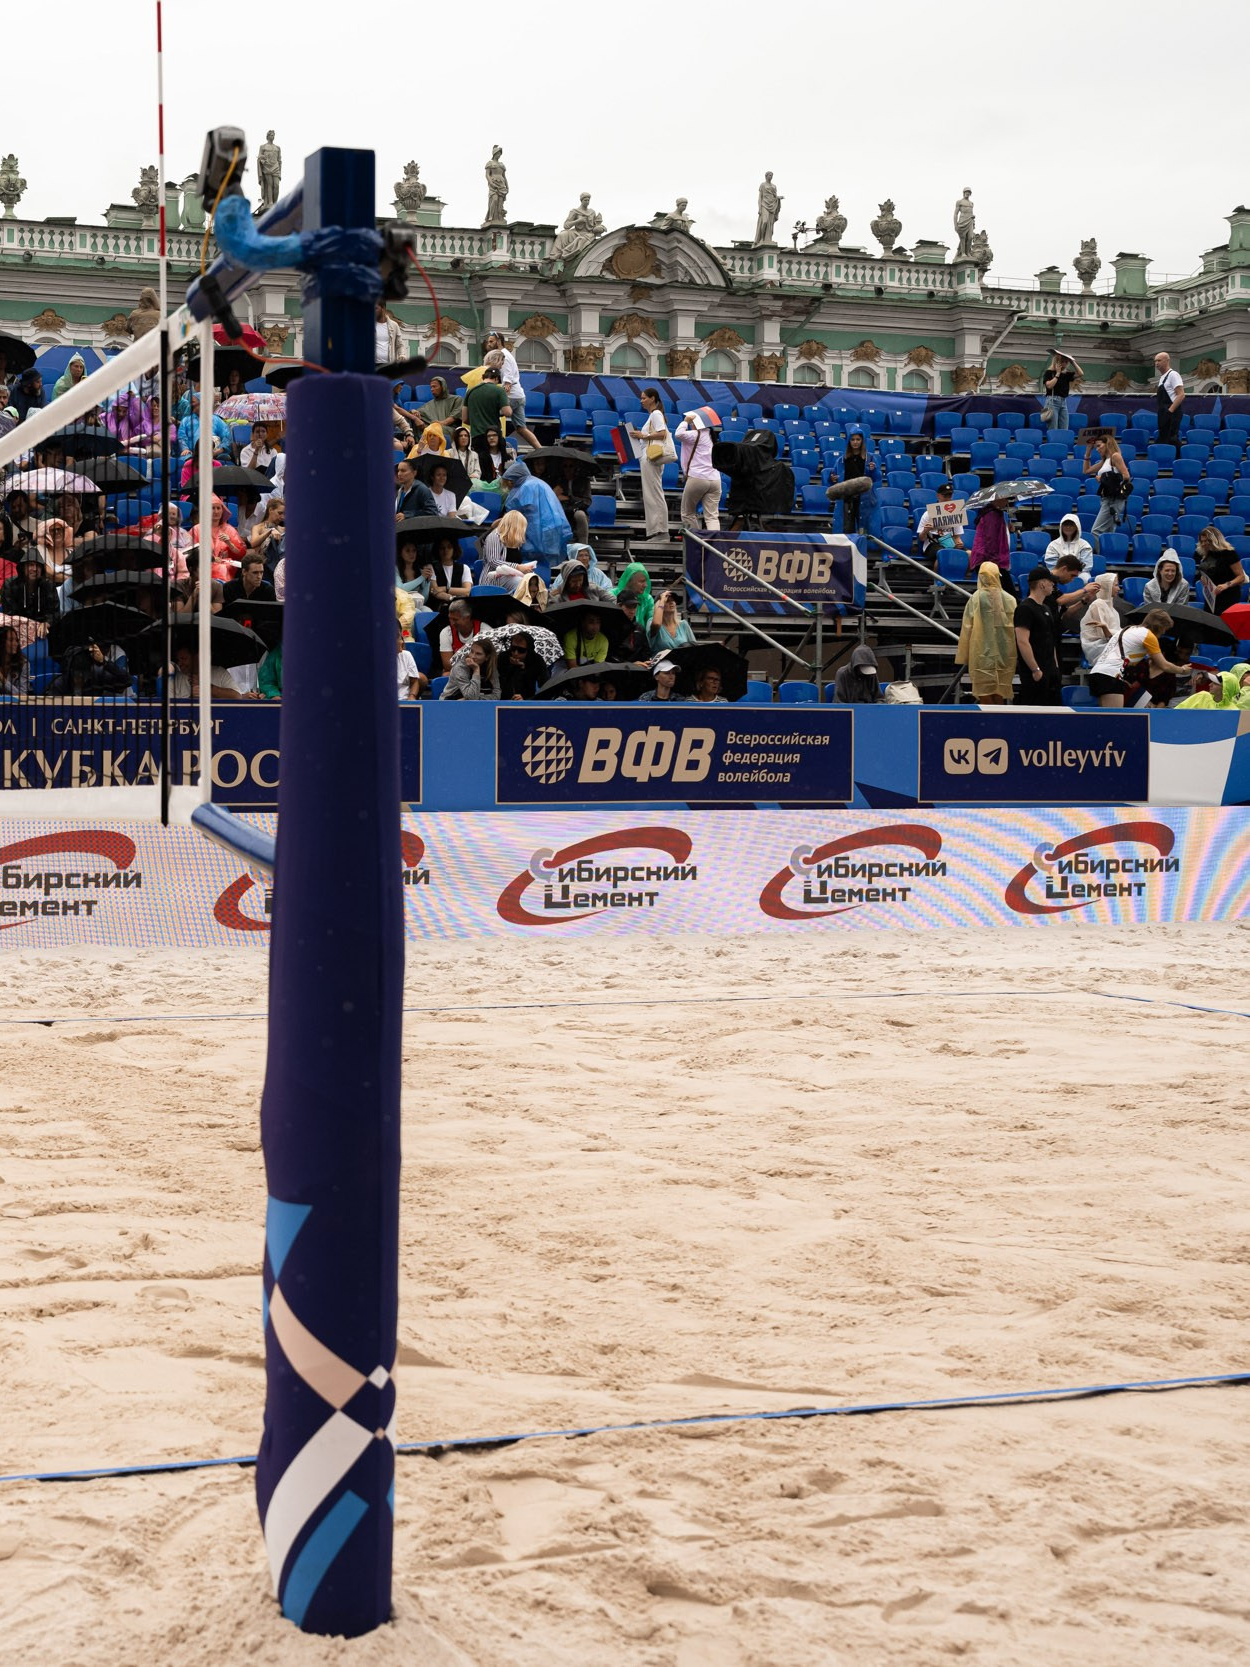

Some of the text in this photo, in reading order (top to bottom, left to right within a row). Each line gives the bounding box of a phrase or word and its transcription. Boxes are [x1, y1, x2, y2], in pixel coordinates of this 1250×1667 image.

[757, 550, 834, 584] ВФВ
[723, 584, 767, 594] Всероссийская
[803, 587, 836, 595] волейбола
[726, 730, 830, 747] Всероссийская
[577, 725, 716, 783] ВФВ
[722, 749, 801, 766] федерация
[1019, 741, 1127, 774] volleyvfv
[3, 748, 161, 789] КУБКА
[182, 749, 281, 788] РОС
[717, 768, 791, 783] волейбола
[544, 884, 659, 909] Цемент
[803, 880, 911, 904] Цемент
[1045, 875, 1146, 899] Цемент
